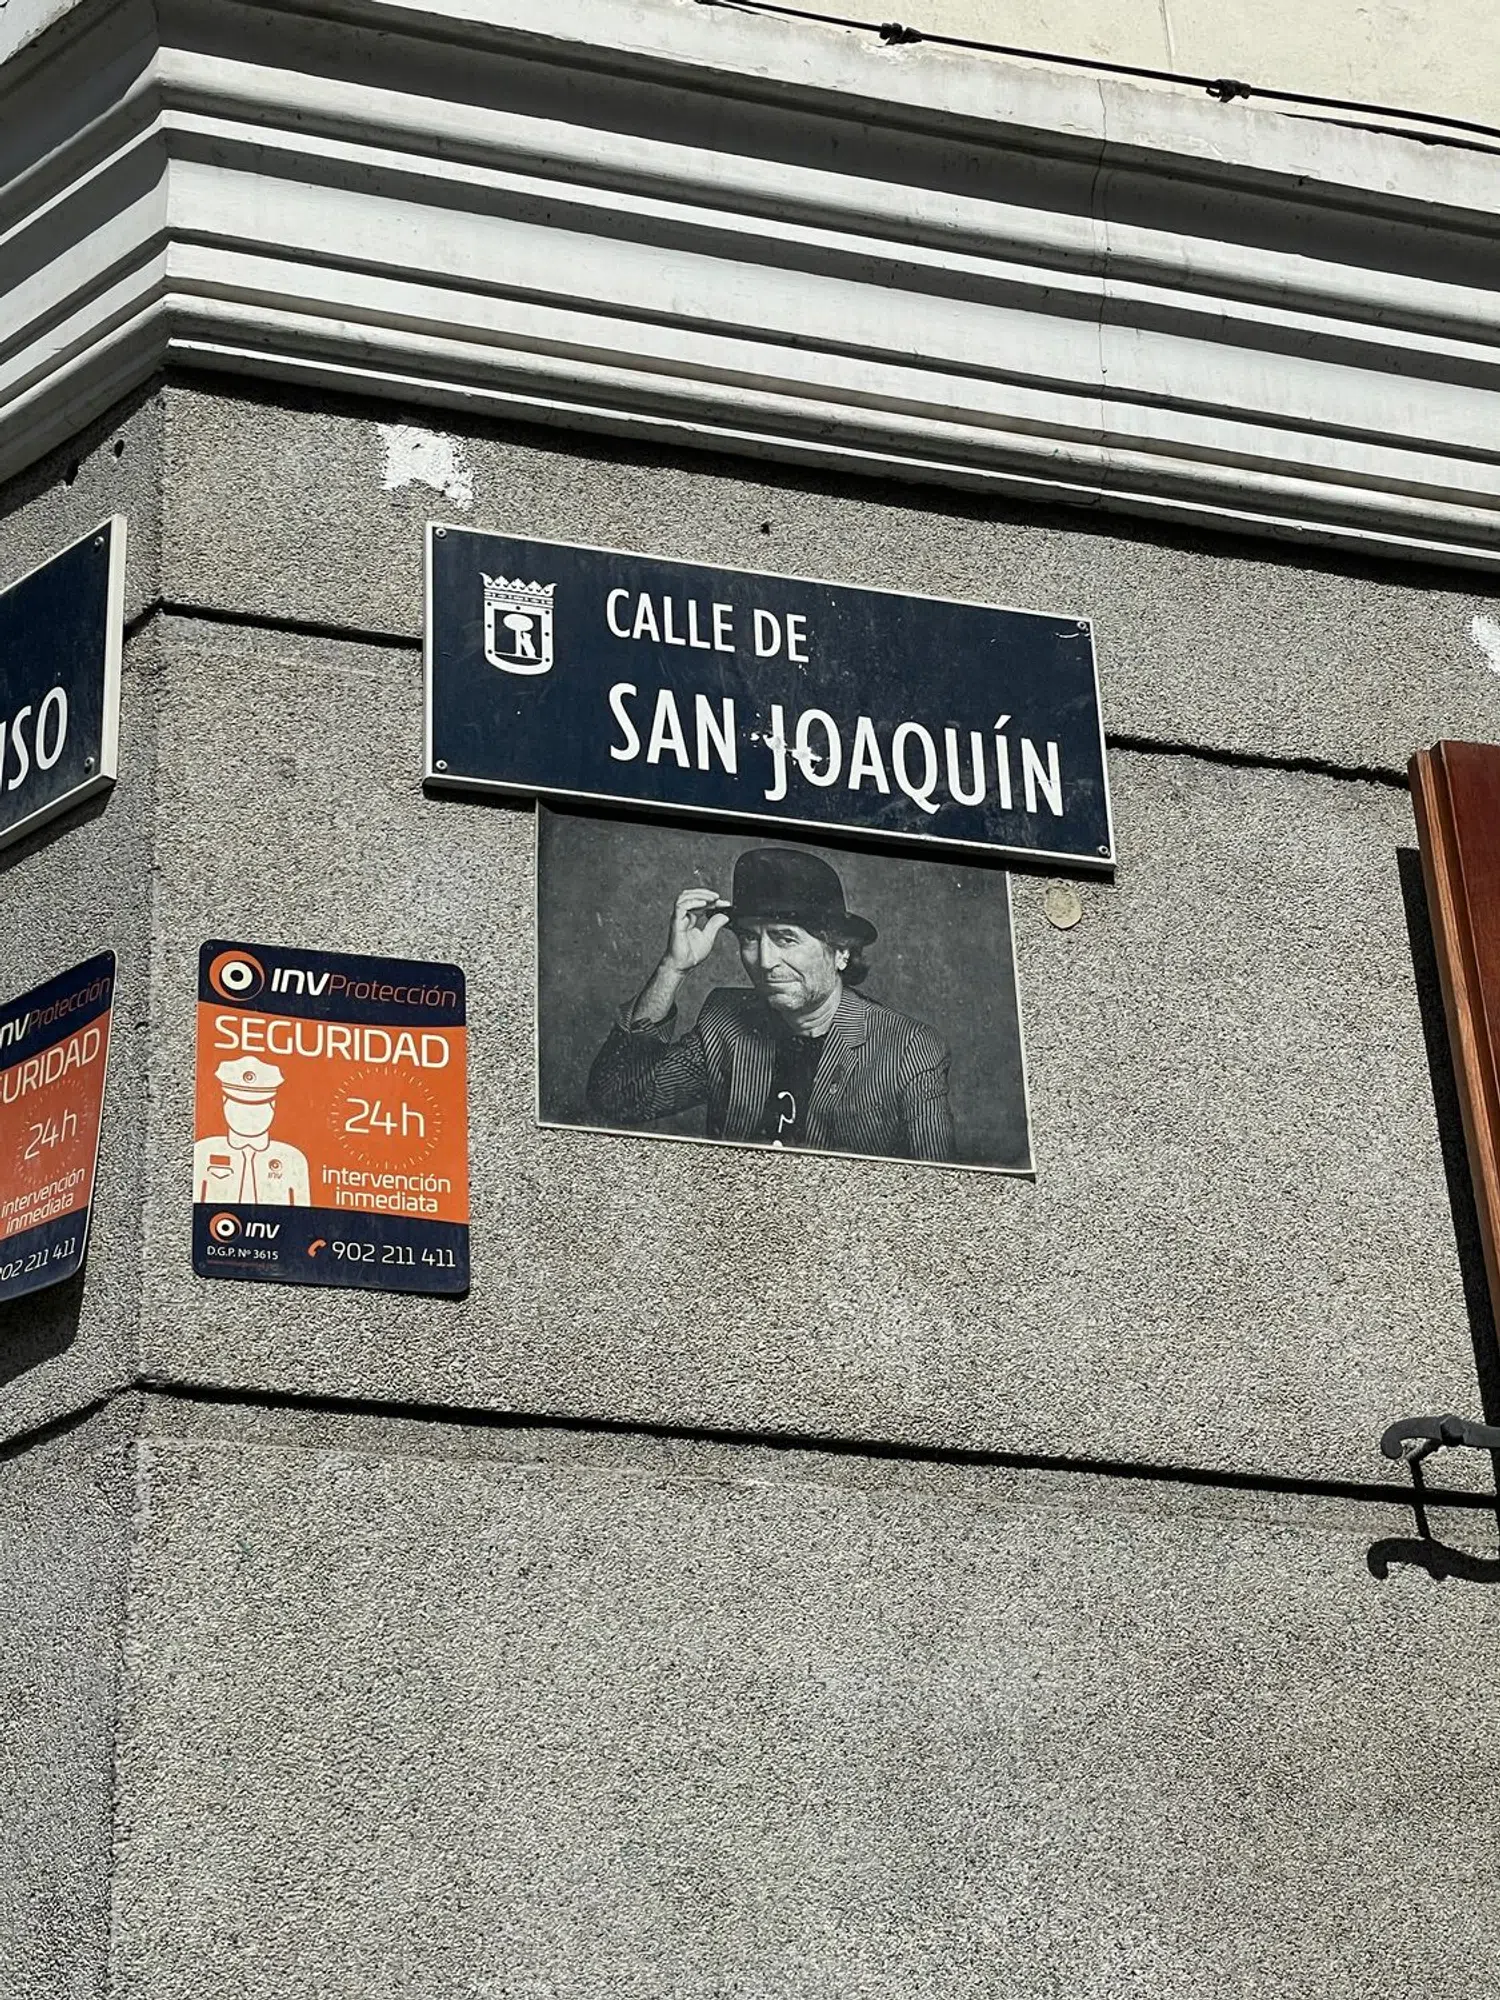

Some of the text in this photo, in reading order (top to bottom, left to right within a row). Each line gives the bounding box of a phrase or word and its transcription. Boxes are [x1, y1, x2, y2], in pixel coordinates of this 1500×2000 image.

[606, 588, 810, 664] CALLE DE
[0, 686, 68, 792] SO
[608, 682, 1064, 818] SAN JOAQUÍN
[214, 1014, 450, 1069] SEGURIDAD
[0, 1027, 100, 1104] URIDAD
[24, 1109, 78, 1161] 24h
[345, 1097, 425, 1138] 24h
[1, 1167, 86, 1219] intervención
[322, 1164, 451, 1194] intervención
[335, 1186, 439, 1213] inmediata
[6, 1192, 75, 1235] inmediata
[24, 1248, 49, 1273] 211
[52, 1236, 76, 1260] 411
[206, 1245, 236, 1258] D.G.P.
[253, 1249, 279, 1261] 3615
[332, 1241, 456, 1268] 902 211 411
